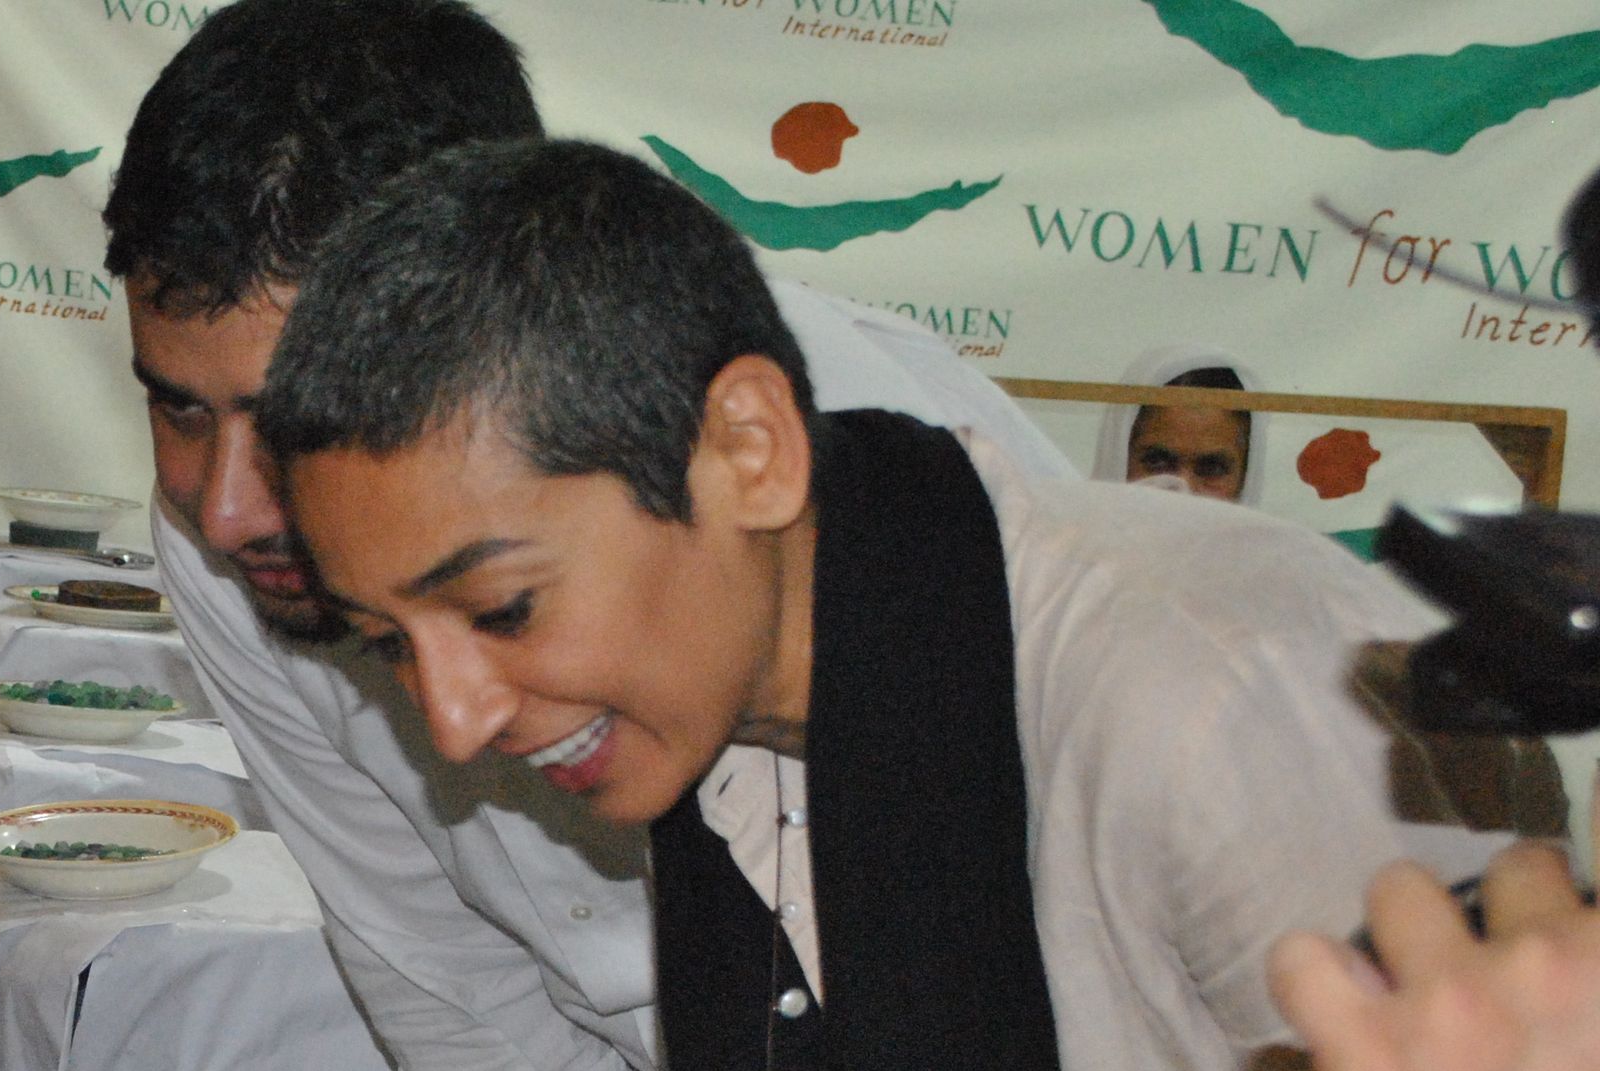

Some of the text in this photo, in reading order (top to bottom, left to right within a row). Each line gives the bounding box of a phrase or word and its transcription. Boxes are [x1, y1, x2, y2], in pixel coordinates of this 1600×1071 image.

[103, 0, 212, 31] WOM
[782, 15, 949, 47] International
[1022, 203, 1320, 284] WOMEN
[1347, 209, 1451, 288] for
[886, 302, 1012, 339] OMEN
